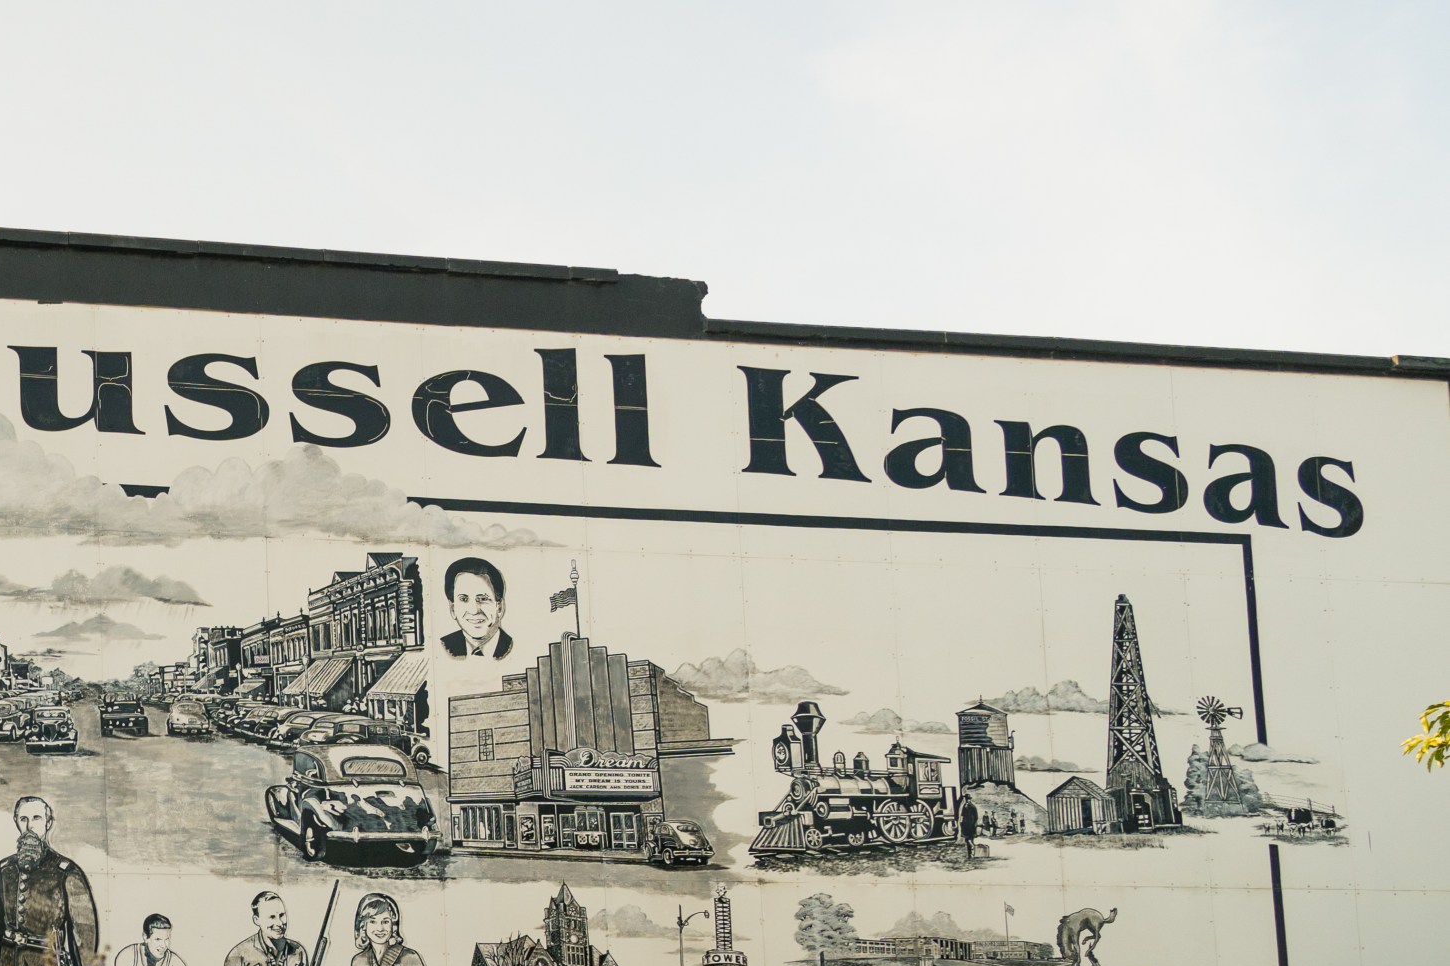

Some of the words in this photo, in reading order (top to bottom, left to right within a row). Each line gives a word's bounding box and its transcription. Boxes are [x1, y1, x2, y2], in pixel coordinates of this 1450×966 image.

[737, 366, 1364, 538] Kansas
[575, 748, 647, 768] Dream
[705, 954, 748, 964] TOWER
